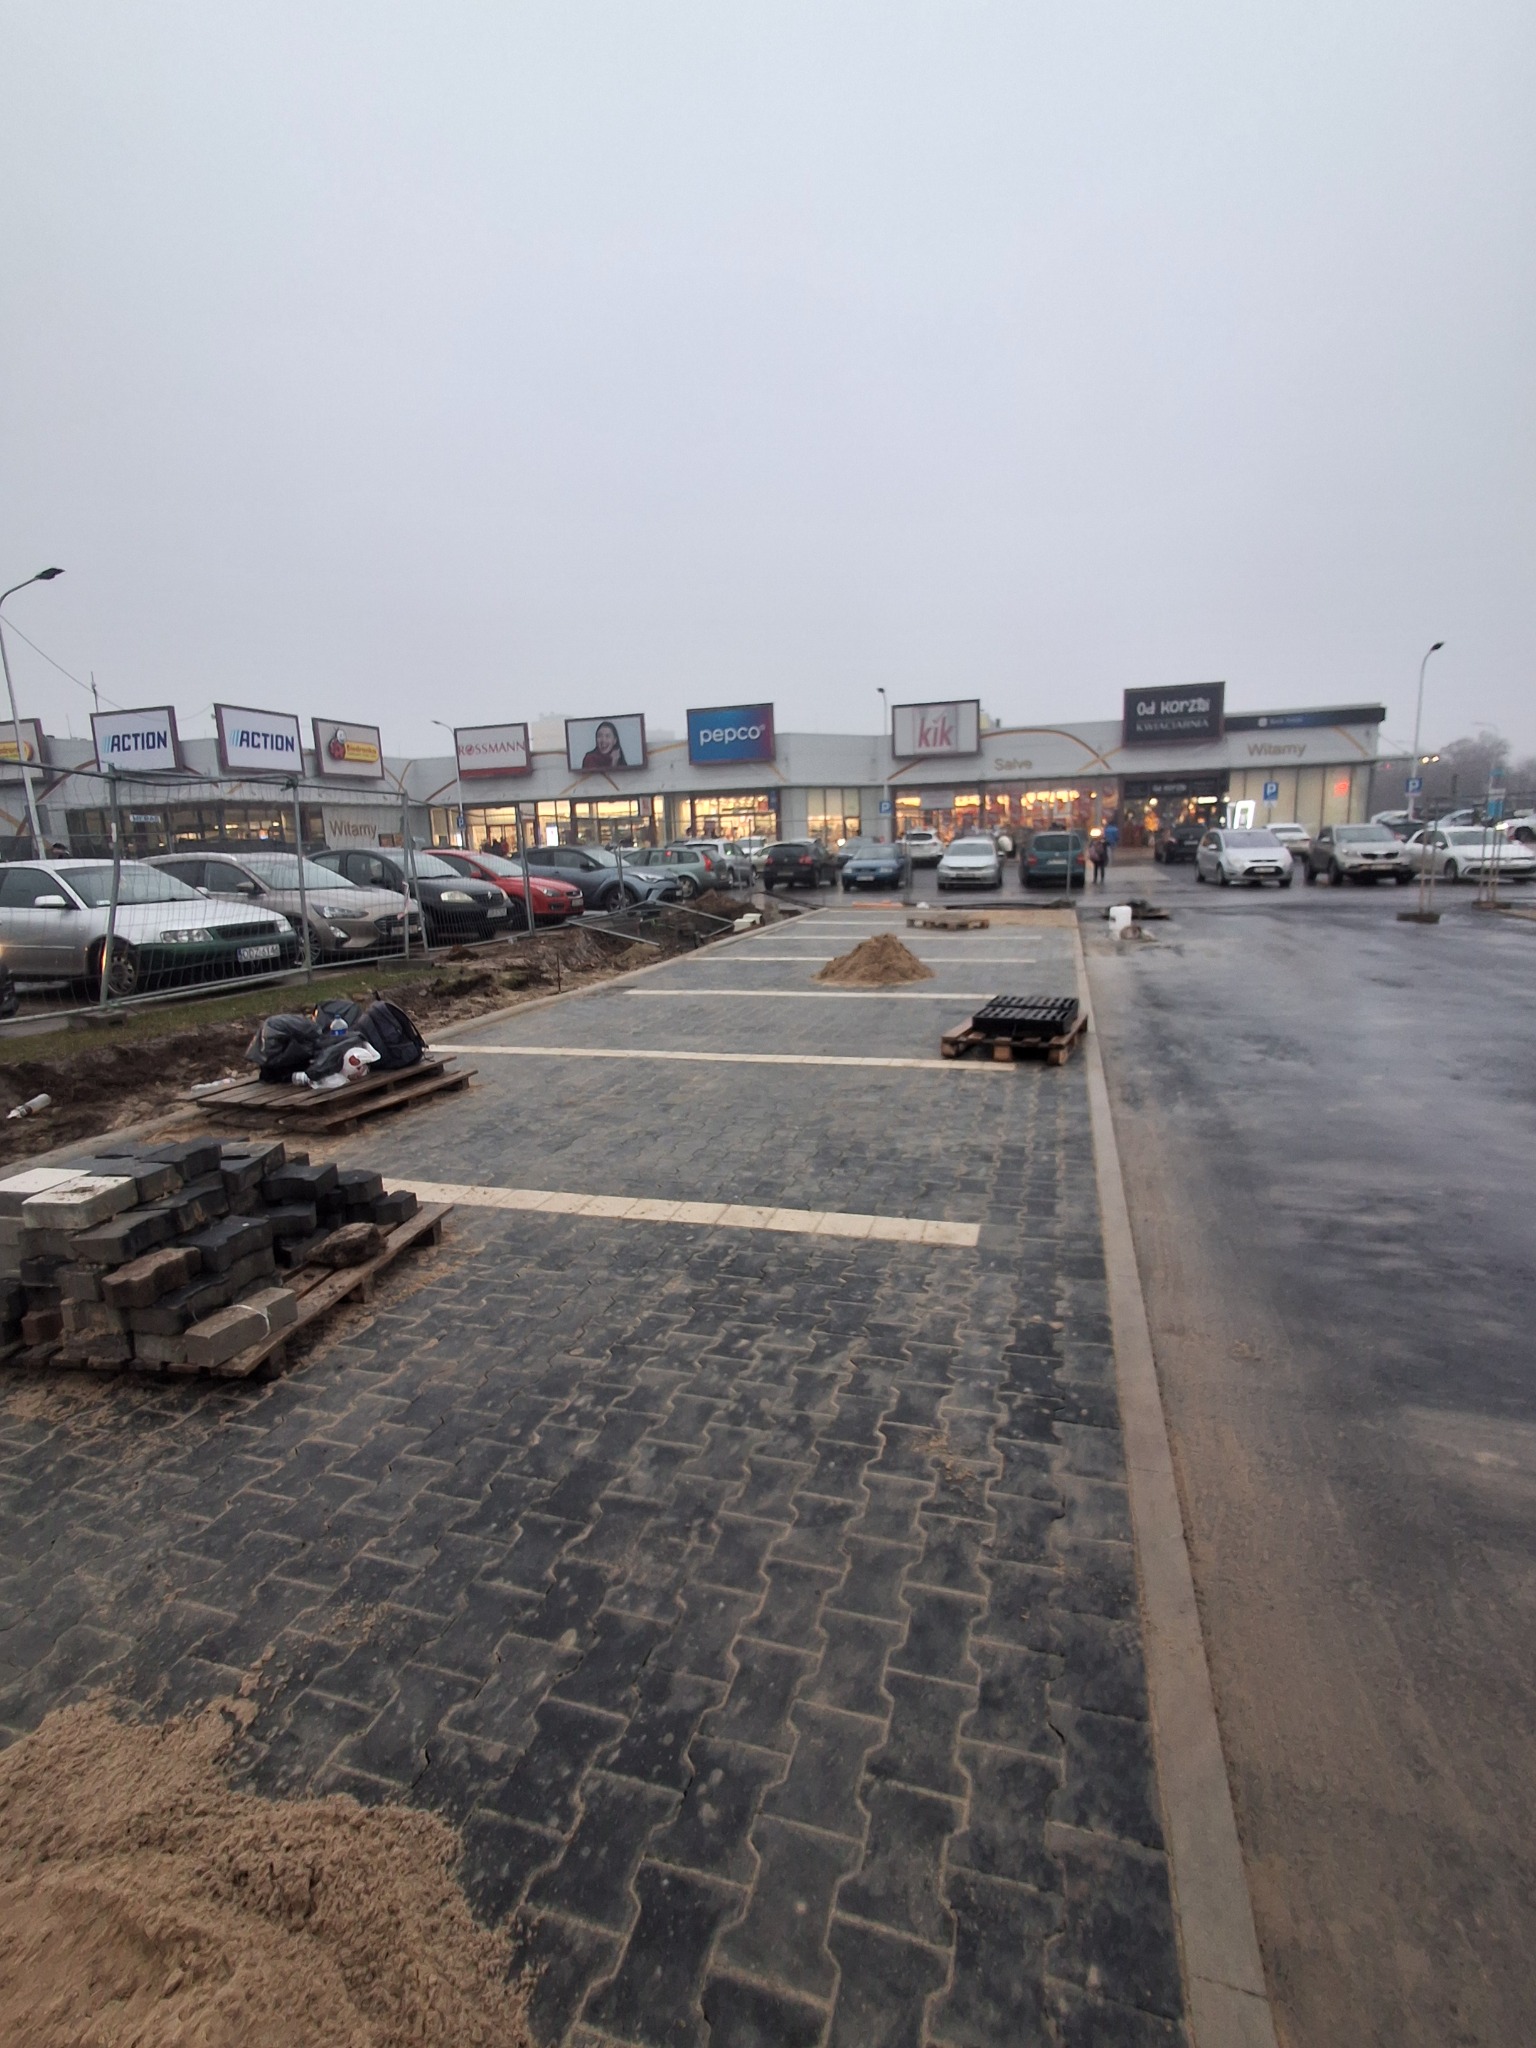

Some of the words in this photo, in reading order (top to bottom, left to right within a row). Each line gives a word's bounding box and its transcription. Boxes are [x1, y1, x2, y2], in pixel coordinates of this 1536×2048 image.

[110, 731, 168, 753] ACTION
[238, 730, 295, 753] ACTION
[700, 725, 761, 747] pepco
[457, 740, 526, 756] ROSSMANN
[1247, 742, 1307, 758] Witamy
[1266, 783, 1276, 794] P
[1409, 779, 1420, 791] P
[881, 802, 890, 812] P
[329, 820, 377, 840] Witamy
